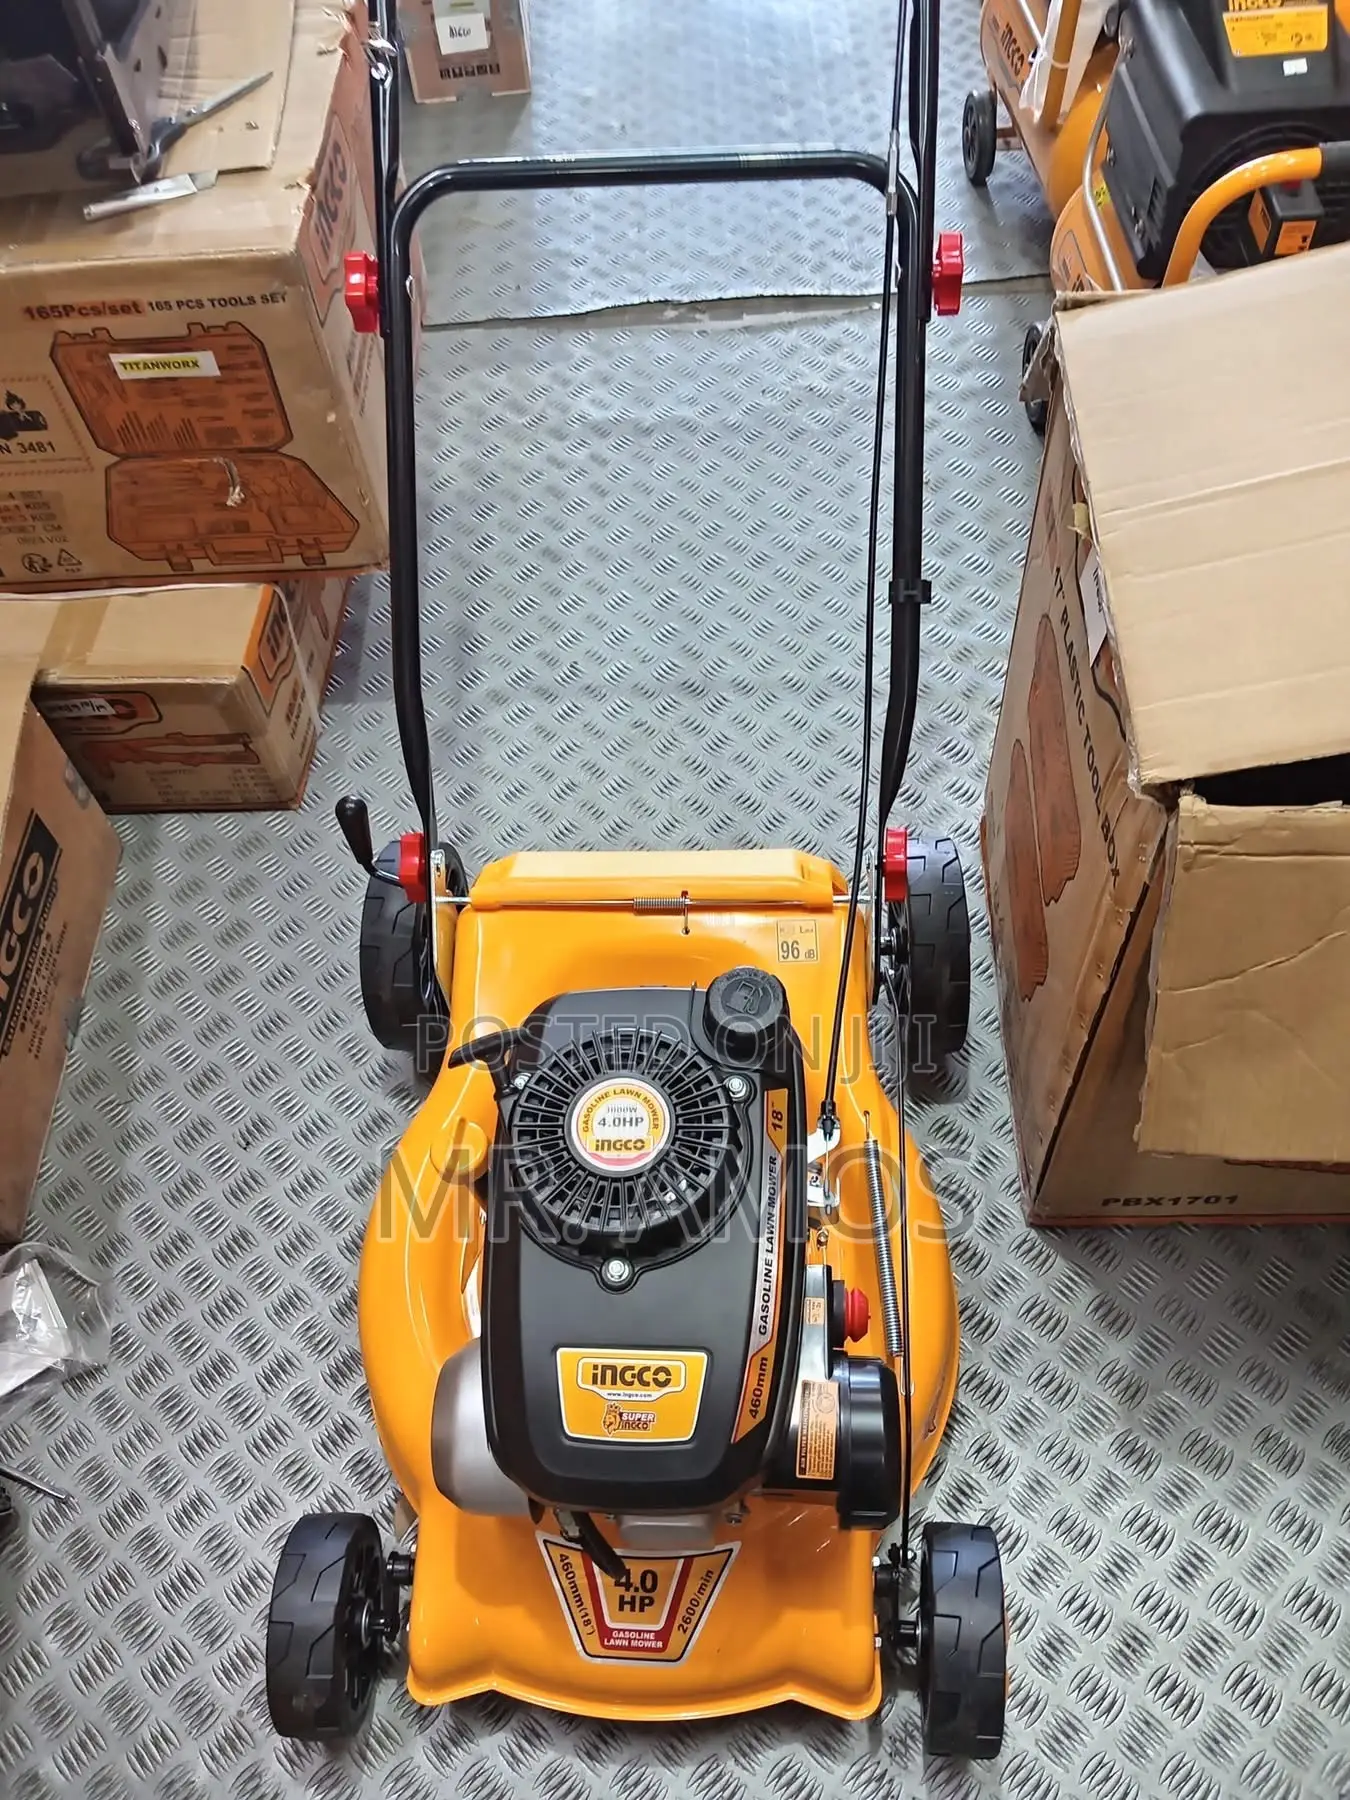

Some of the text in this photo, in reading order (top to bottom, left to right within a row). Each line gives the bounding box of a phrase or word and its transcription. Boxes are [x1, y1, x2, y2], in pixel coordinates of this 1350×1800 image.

[23, 291, 288, 321] 165Pcs/set 165 PCS TOOLS SET
[119, 356, 201, 372] TITANWORX
[17, 441, 56, 454] 3481
[1060, 605, 1086, 726] PLASTIC
[1083, 723, 1102, 815] TOOL
[1101, 811, 1120, 889] BOX
[780, 940, 800, 960] 96
[583, 1088, 660, 1133] GASOLINE LAWN MOWER
[597, 1116, 644, 1128] 4.0HP
[1101, 1195, 1239, 1207] PBX1701
[758, 1155, 777, 1337] GASOLINE LAWN MOWER
[749, 1357, 768, 1421] 460mm
[622, 1412, 655, 1421] SUPER
[614, 1567, 659, 1594] 4.0
[618, 1595, 656, 1613] HP
[677, 1569, 715, 1636] 2600/min
[604, 1638, 663, 1649] LAWN MOWER
[612, 1630, 656, 1640] GASOLINE
